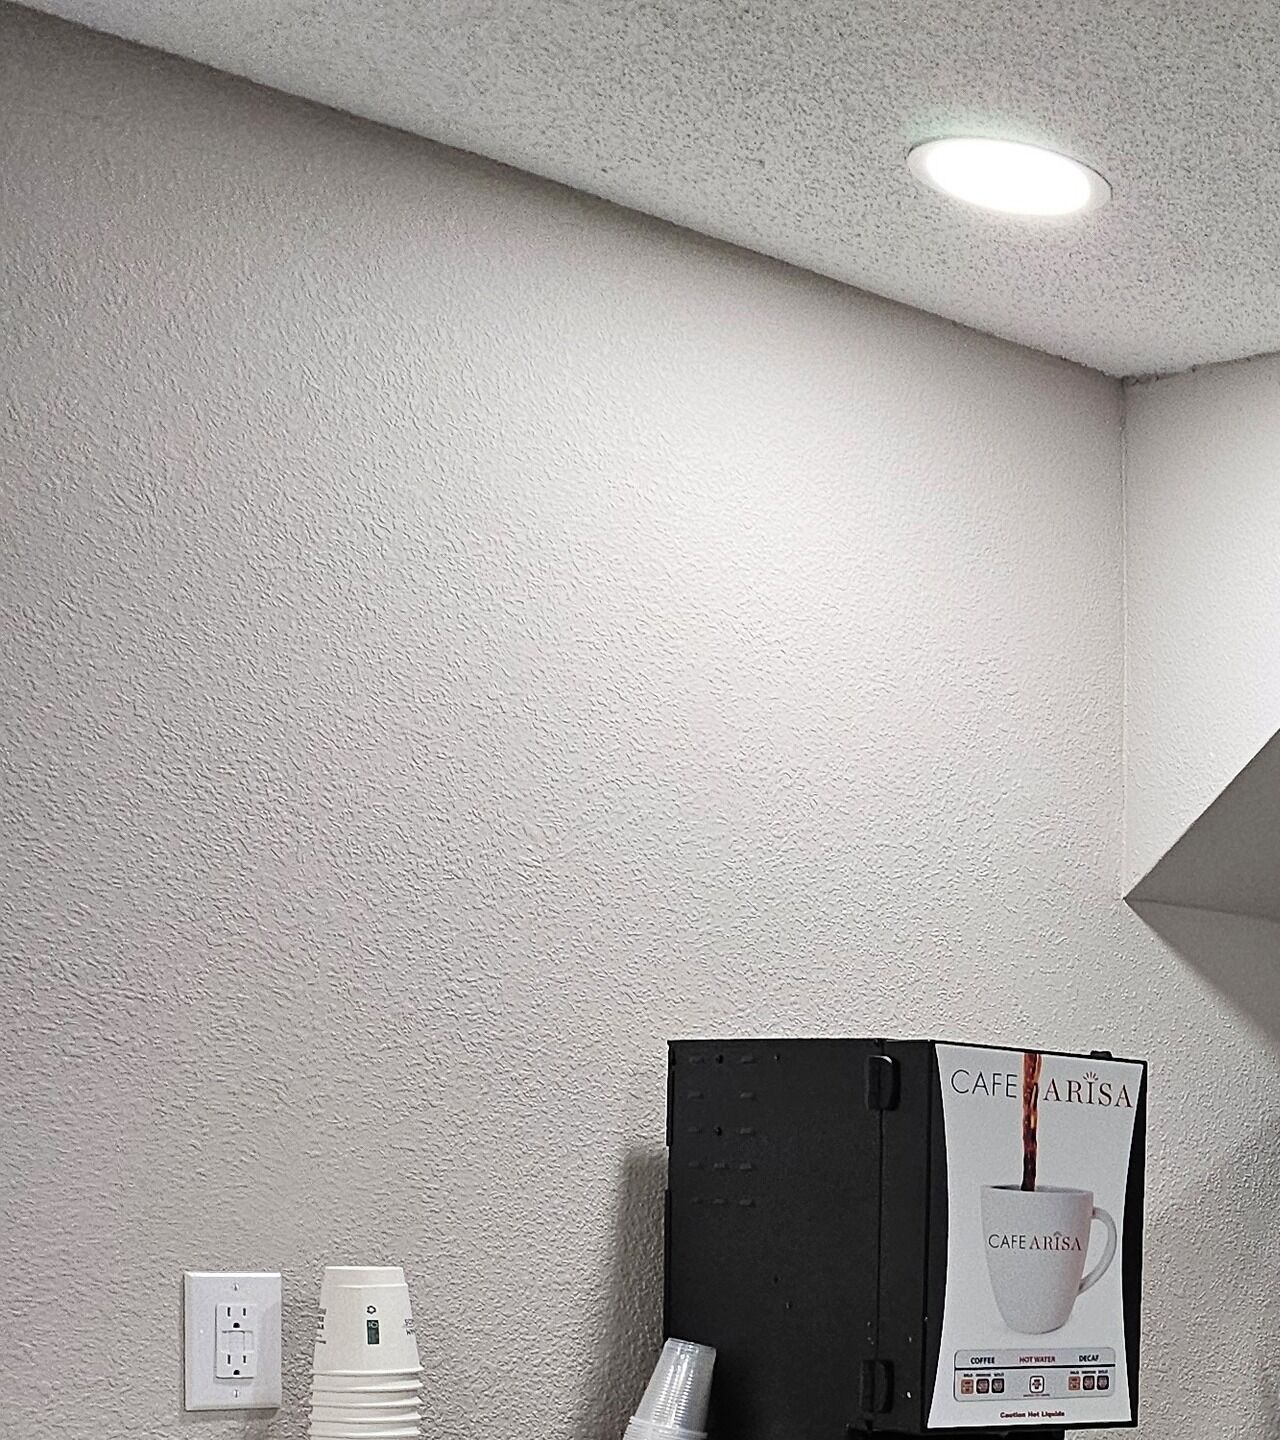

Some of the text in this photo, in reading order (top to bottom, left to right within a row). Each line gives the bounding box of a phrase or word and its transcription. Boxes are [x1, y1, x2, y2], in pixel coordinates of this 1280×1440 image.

[950, 1069, 1134, 1109] CAFE ARISA
[988, 1230, 1082, 1251] CAFE ARISA
[970, 1355, 996, 1364] COFFEE
[1019, 1355, 1056, 1363] HOT WATER
[1078, 1354, 1100, 1363] DECAF
